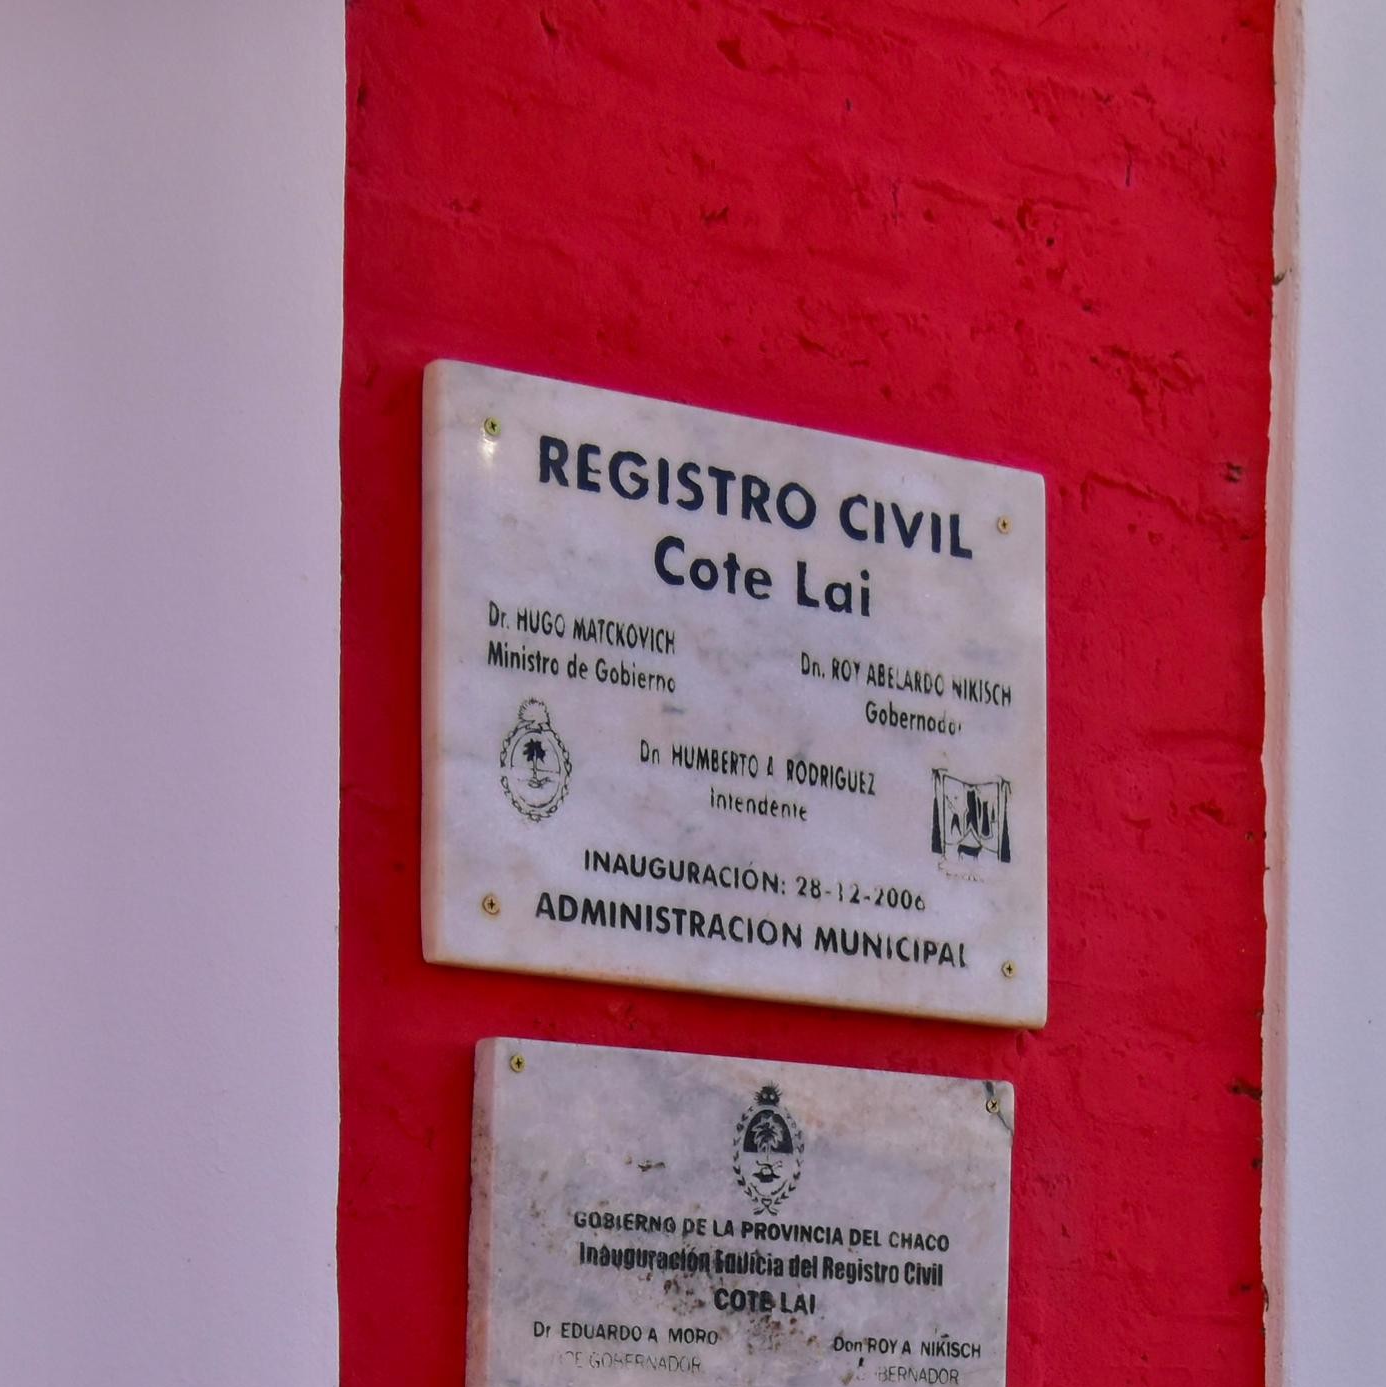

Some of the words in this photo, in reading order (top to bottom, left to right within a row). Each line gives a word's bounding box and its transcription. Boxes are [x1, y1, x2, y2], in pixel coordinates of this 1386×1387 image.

[539, 434, 817, 530] REGISTRO
[839, 494, 973, 560] CIVIL
[654, 535, 773, 600] Cote
[796, 560, 871, 617] Lai
[488, 600, 509, 629] Dr.
[517, 607, 565, 638] HUGO
[573, 617, 675, 654] MATCKOVICH
[487, 640, 559, 676] Ministro
[567, 653, 588, 679] de
[595, 658, 676, 693] Gobierno
[801, 651, 825, 679] Dn.
[831, 656, 861, 686] ROY
[866, 663, 945, 697] ABELARDO
[951, 675, 1012, 707] NIKISCH
[671, 743, 758, 778] HUMBERTO
[786, 759, 876, 796] RODRIGUEZ
[583, 848, 786, 895] INAUGURACIÓN:
[795, 875, 926, 912] 28-12-2006
[814, 926, 969, 969] MUNICIPAL
[573, 1210, 677, 1234] GOBIERNO
[682, 1217, 707, 1237] DE
[713, 1219, 734, 1238] LA
[741, 1222, 843, 1247] PROVINCIA
[849, 1228, 882, 1249] DEL
[888, 1231, 950, 1252] CHACO
[579, 1241, 711, 1274] Inauguración
[789, 1253, 818, 1280] del
[822, 1257, 900, 1286] Registro
[904, 1261, 944, 1287] Civil
[780, 1293, 816, 1315] LAI
[561, 1322, 642, 1342] EDUARDO
[668, 1327, 719, 1345] MORO
[832, 1336, 863, 1352] Don
[867, 1337, 898, 1354] ROY
[901, 1340, 911, 1355] A
[920, 1340, 981, 1358] NIKISCH
[859, 1364, 960, 1385] BERNADOR
